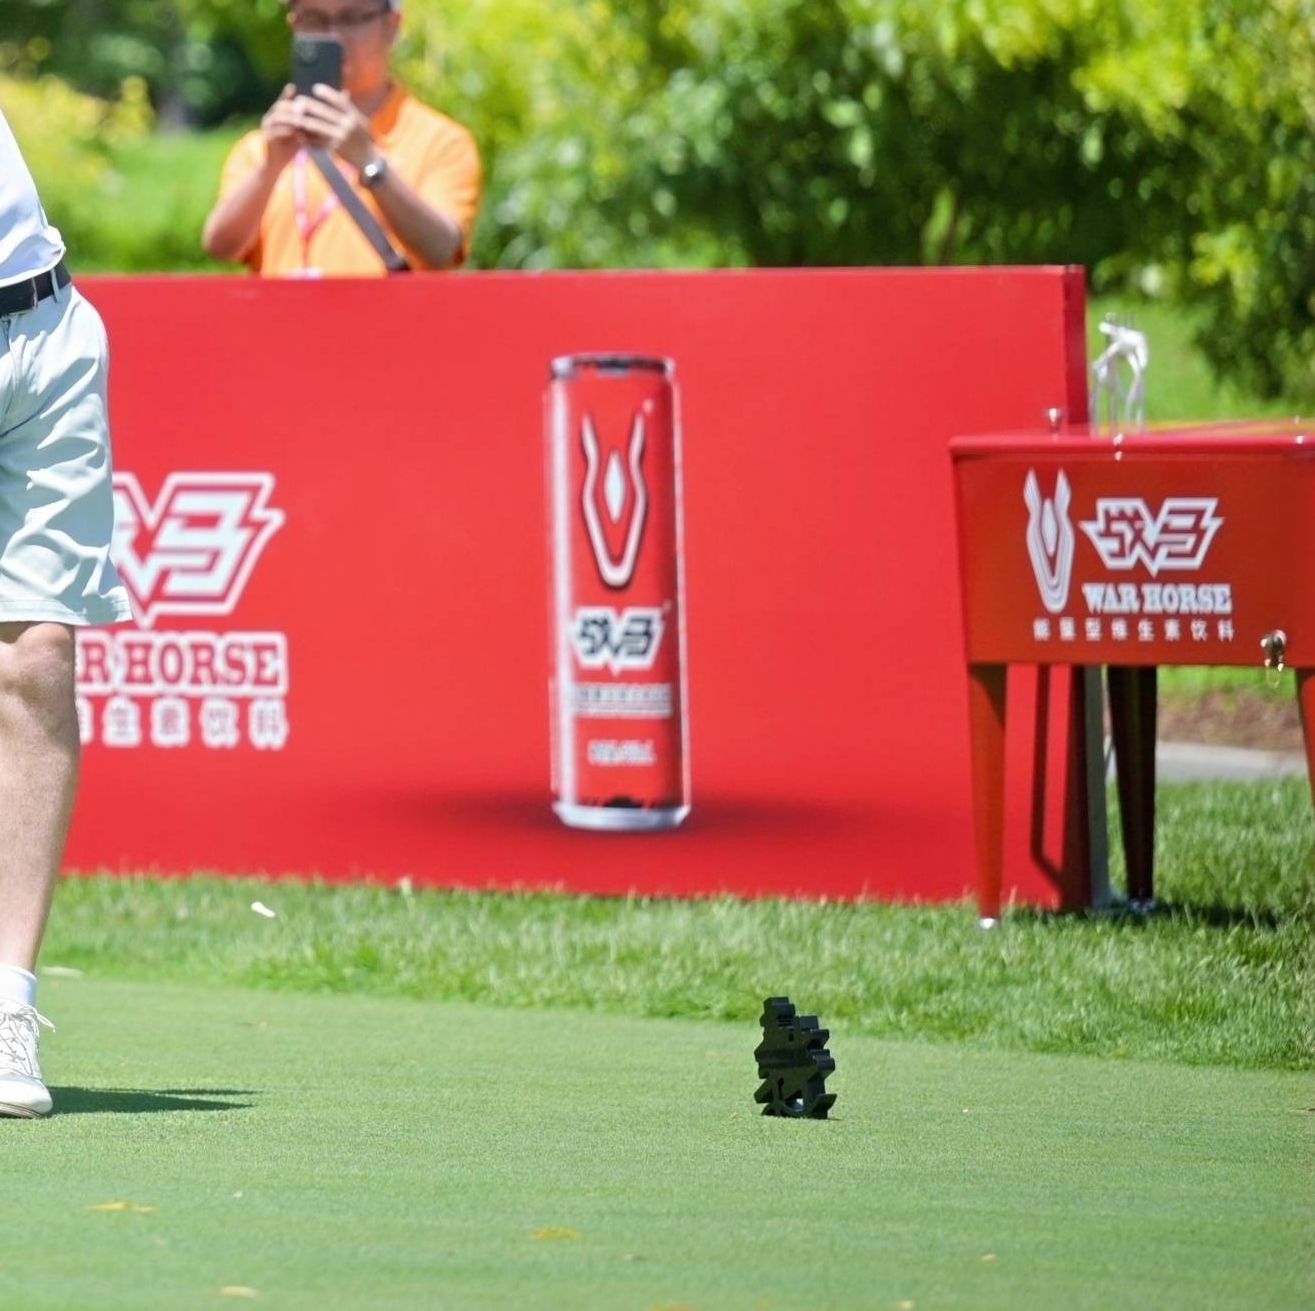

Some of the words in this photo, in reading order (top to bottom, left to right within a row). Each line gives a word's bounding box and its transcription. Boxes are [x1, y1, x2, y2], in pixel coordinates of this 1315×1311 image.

[1081, 582, 1140, 614] WAR
[1141, 582, 1233, 614] HORSE
[122, 639, 283, 689] HORSE
